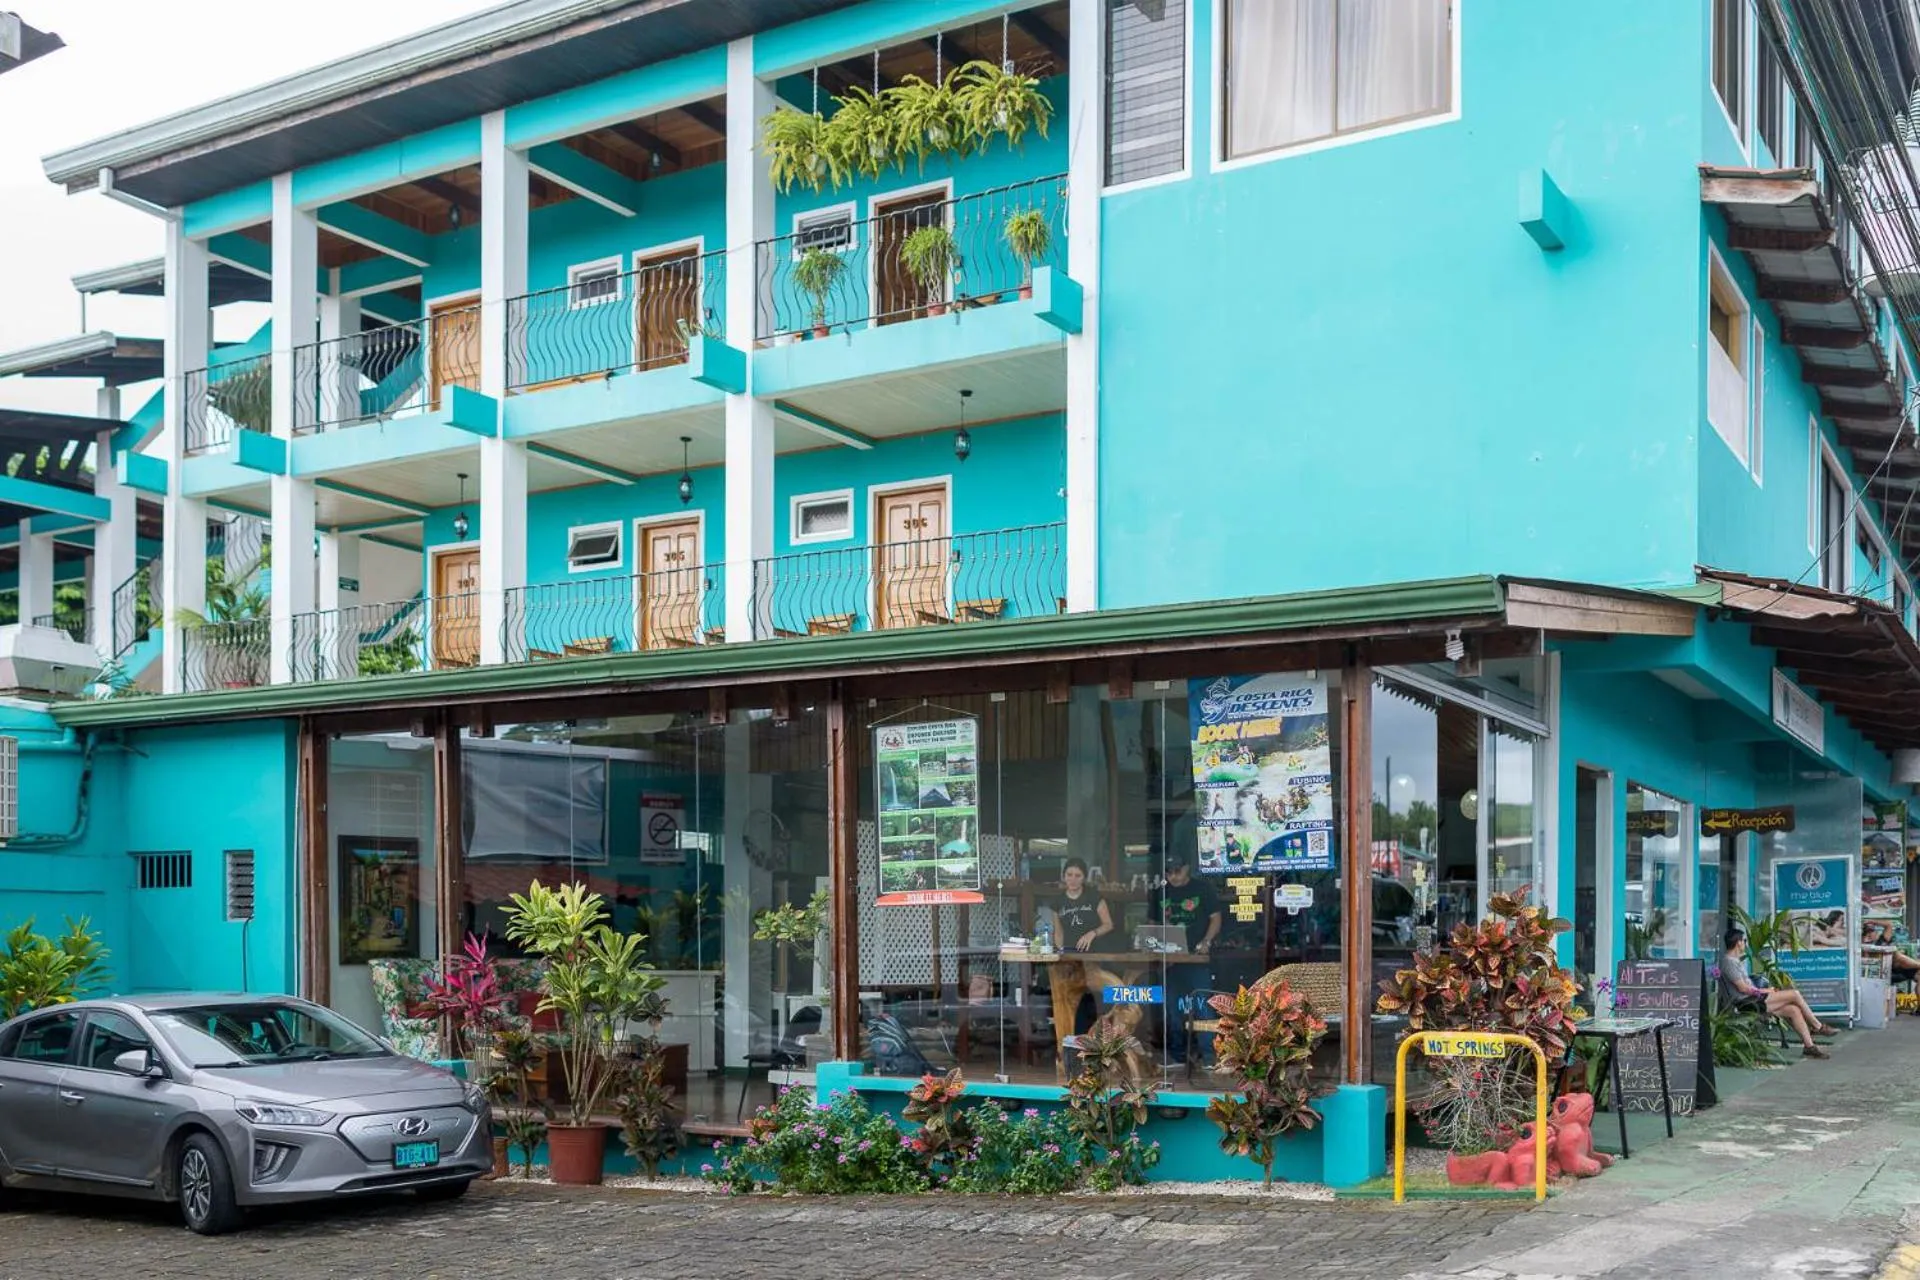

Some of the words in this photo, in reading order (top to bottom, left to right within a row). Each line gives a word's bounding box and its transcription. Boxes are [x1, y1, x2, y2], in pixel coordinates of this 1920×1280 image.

[1236, 691, 1277, 702] COSTA
[1281, 687, 1314, 698] RICA
[1229, 697, 1314, 713] DESCENTS
[1198, 722, 1240, 744] BOOK
[1292, 776, 1327, 785] TUBING
[1288, 821, 1328, 830] RAFTING
[1731, 811, 1786, 830] Recepción
[1809, 889, 1833, 899] blue
[1621, 966, 1633, 985] All
[1636, 968, 1679, 984] Tours
[1428, 1040, 1449, 1053] HOT
[1456, 1041, 1504, 1056] SPRINGS
